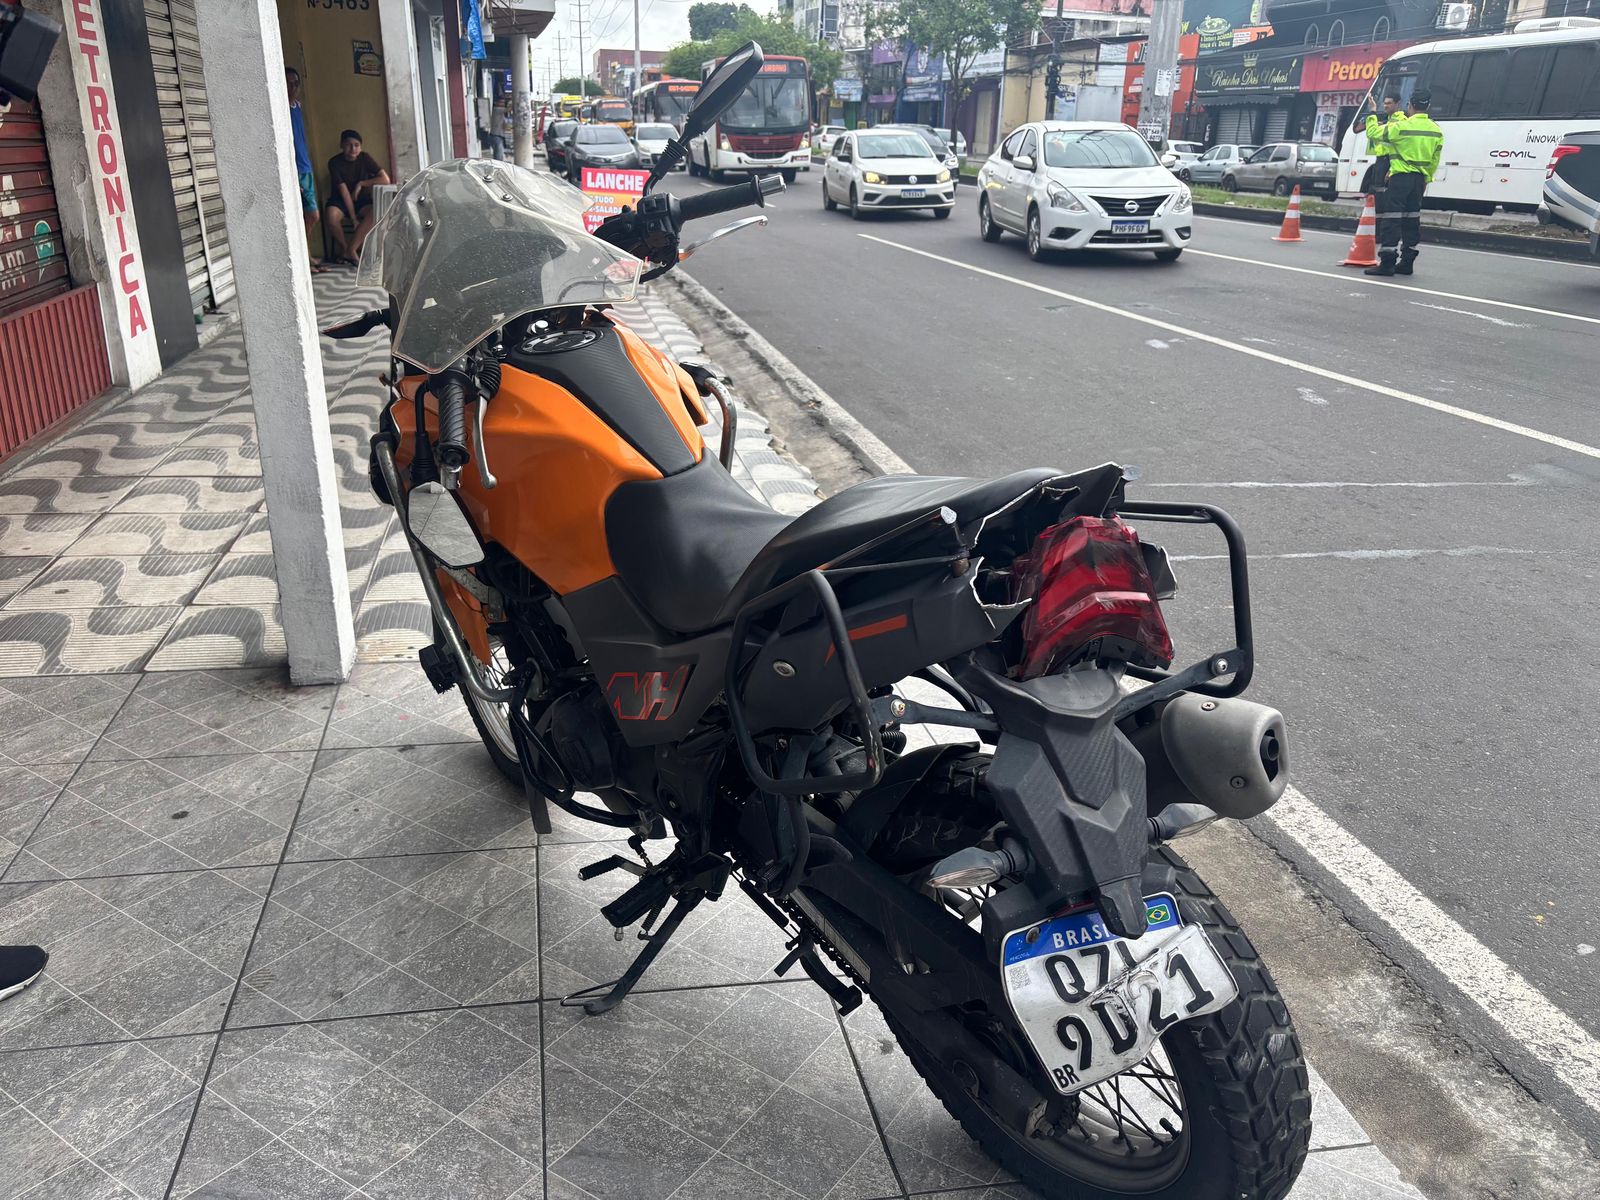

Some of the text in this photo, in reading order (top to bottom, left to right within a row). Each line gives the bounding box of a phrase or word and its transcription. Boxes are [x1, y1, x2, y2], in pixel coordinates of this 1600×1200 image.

[1490, 150, 1537, 159] COMIL
[586, 172, 643, 191] LANCHE
[1053, 923, 1118, 948] BRASI
[1052, 1063, 1080, 1088] BR
